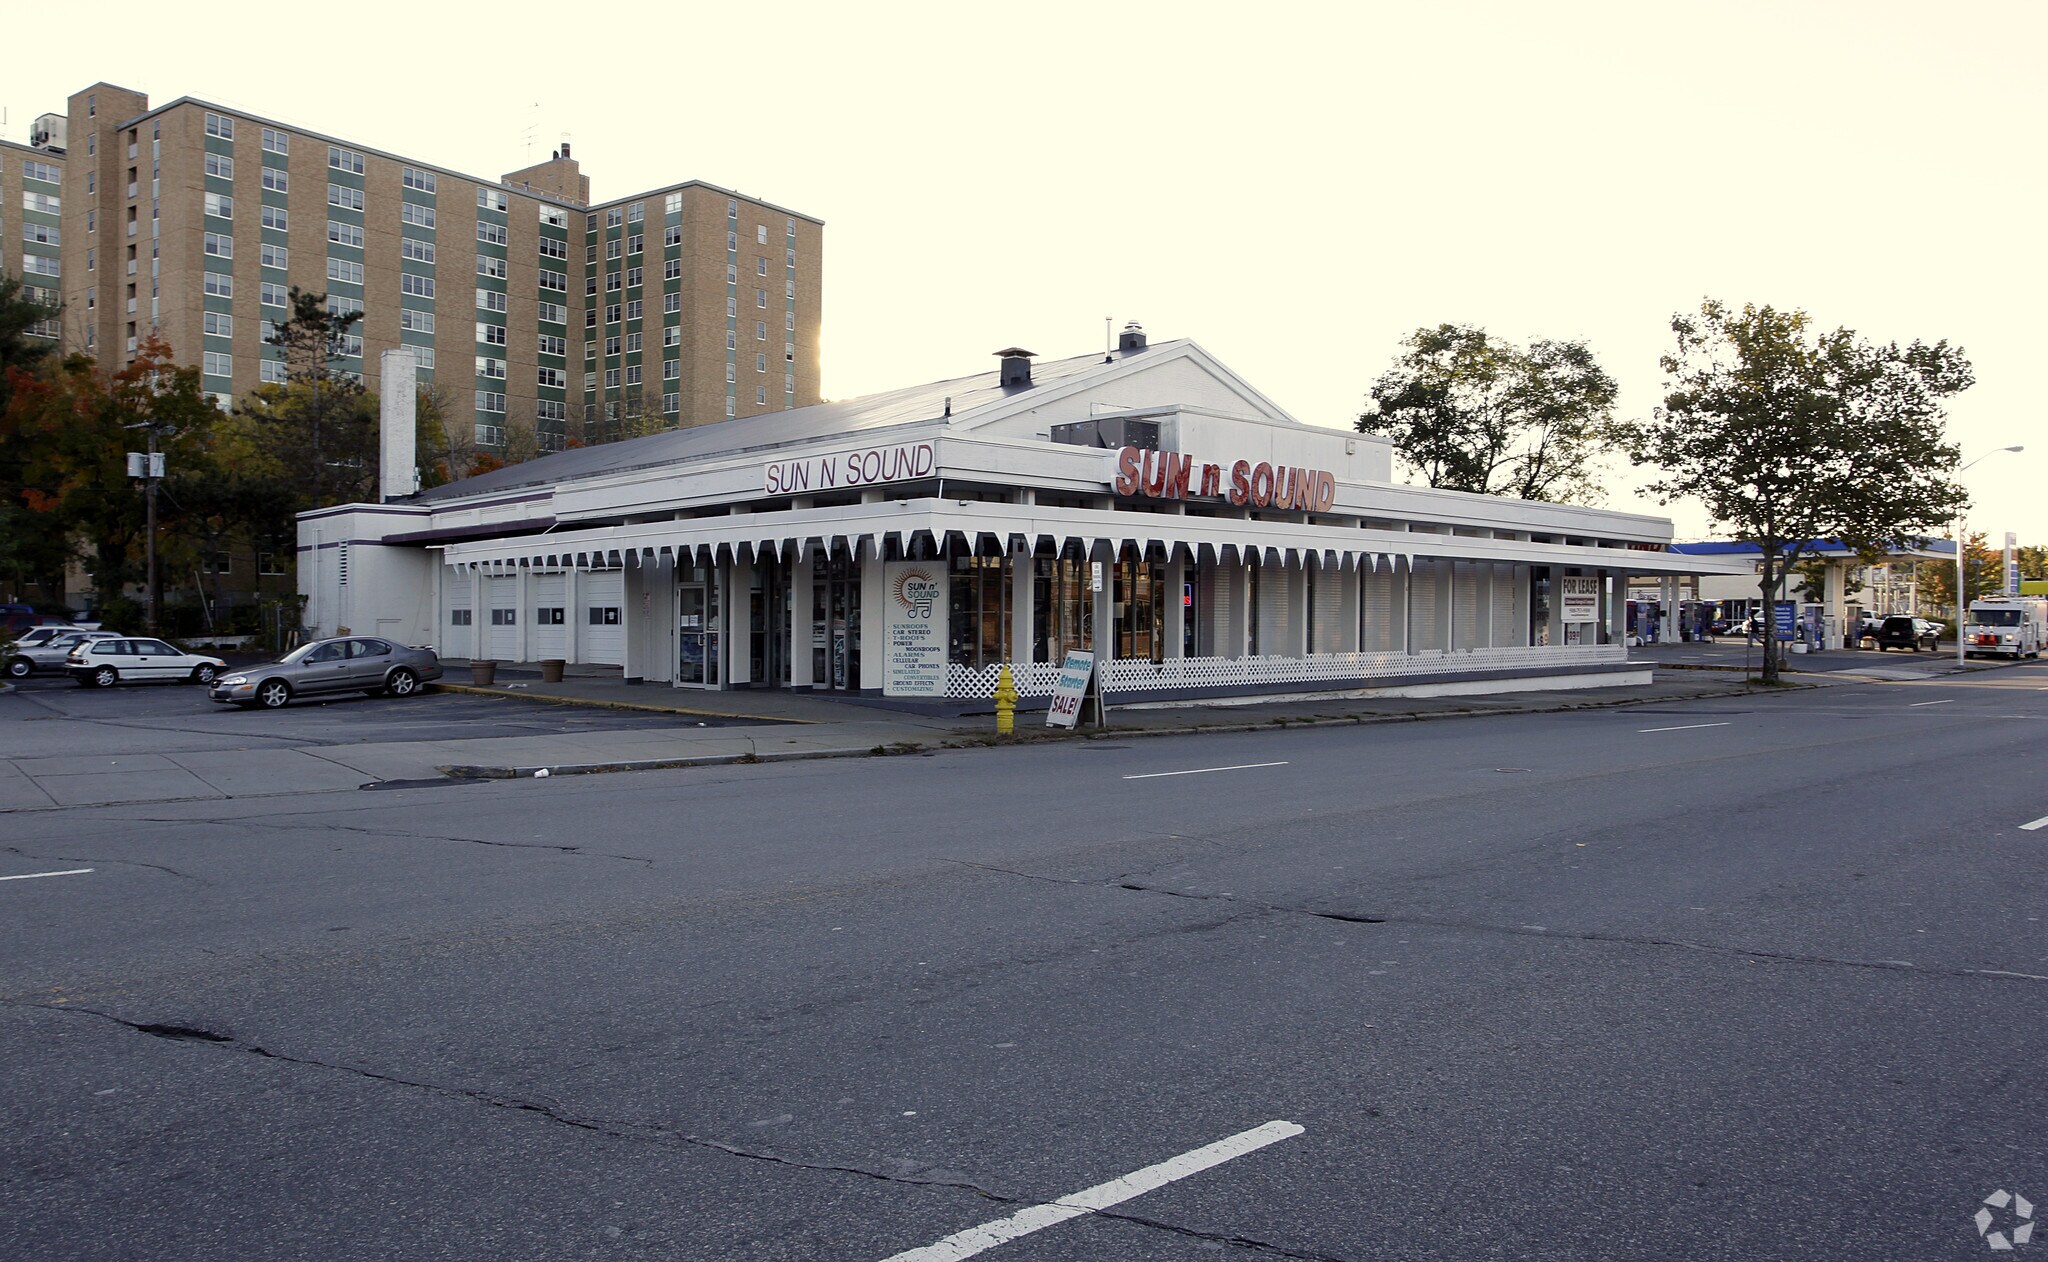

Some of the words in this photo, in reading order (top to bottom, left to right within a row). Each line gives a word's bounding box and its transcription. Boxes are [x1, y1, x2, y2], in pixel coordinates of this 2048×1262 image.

[766, 460, 810, 494] SUN
[820, 457, 837, 489] N
[846, 444, 933, 485] SOUND
[1113, 445, 1192, 499] SUN
[1200, 463, 1220, 497] n
[1227, 459, 1336, 513] SOUND
[907, 582, 927, 591] SUN
[1563, 579, 1577, 594] FOR
[1578, 580, 1597, 594] LEASE
[907, 590, 940, 599] SOUND
[1066, 656, 1091, 671] Remote
[1059, 675, 1085, 689] Starter
[1052, 695, 1078, 715] SALE!
